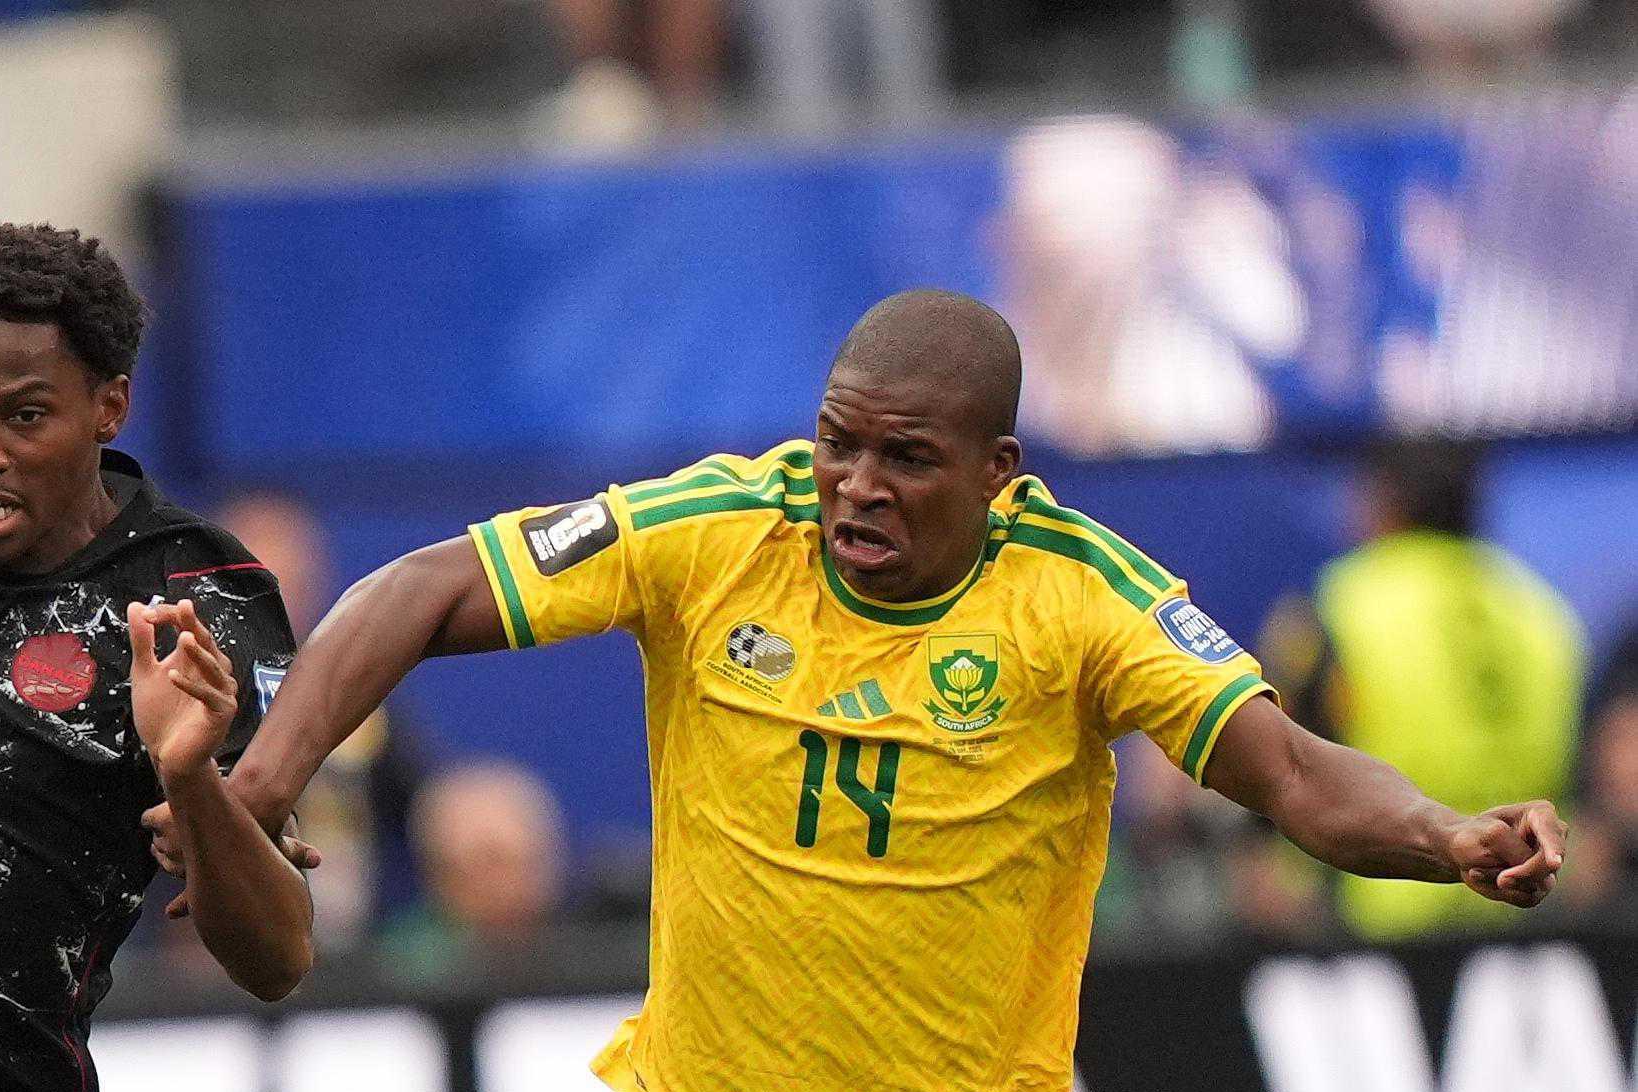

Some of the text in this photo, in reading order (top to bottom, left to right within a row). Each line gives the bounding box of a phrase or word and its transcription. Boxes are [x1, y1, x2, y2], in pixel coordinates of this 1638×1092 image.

[705, 660, 739, 682] FOOTBALL
[936, 715, 994, 731] SOUTH AFRICA
[795, 729, 901, 858] 14
